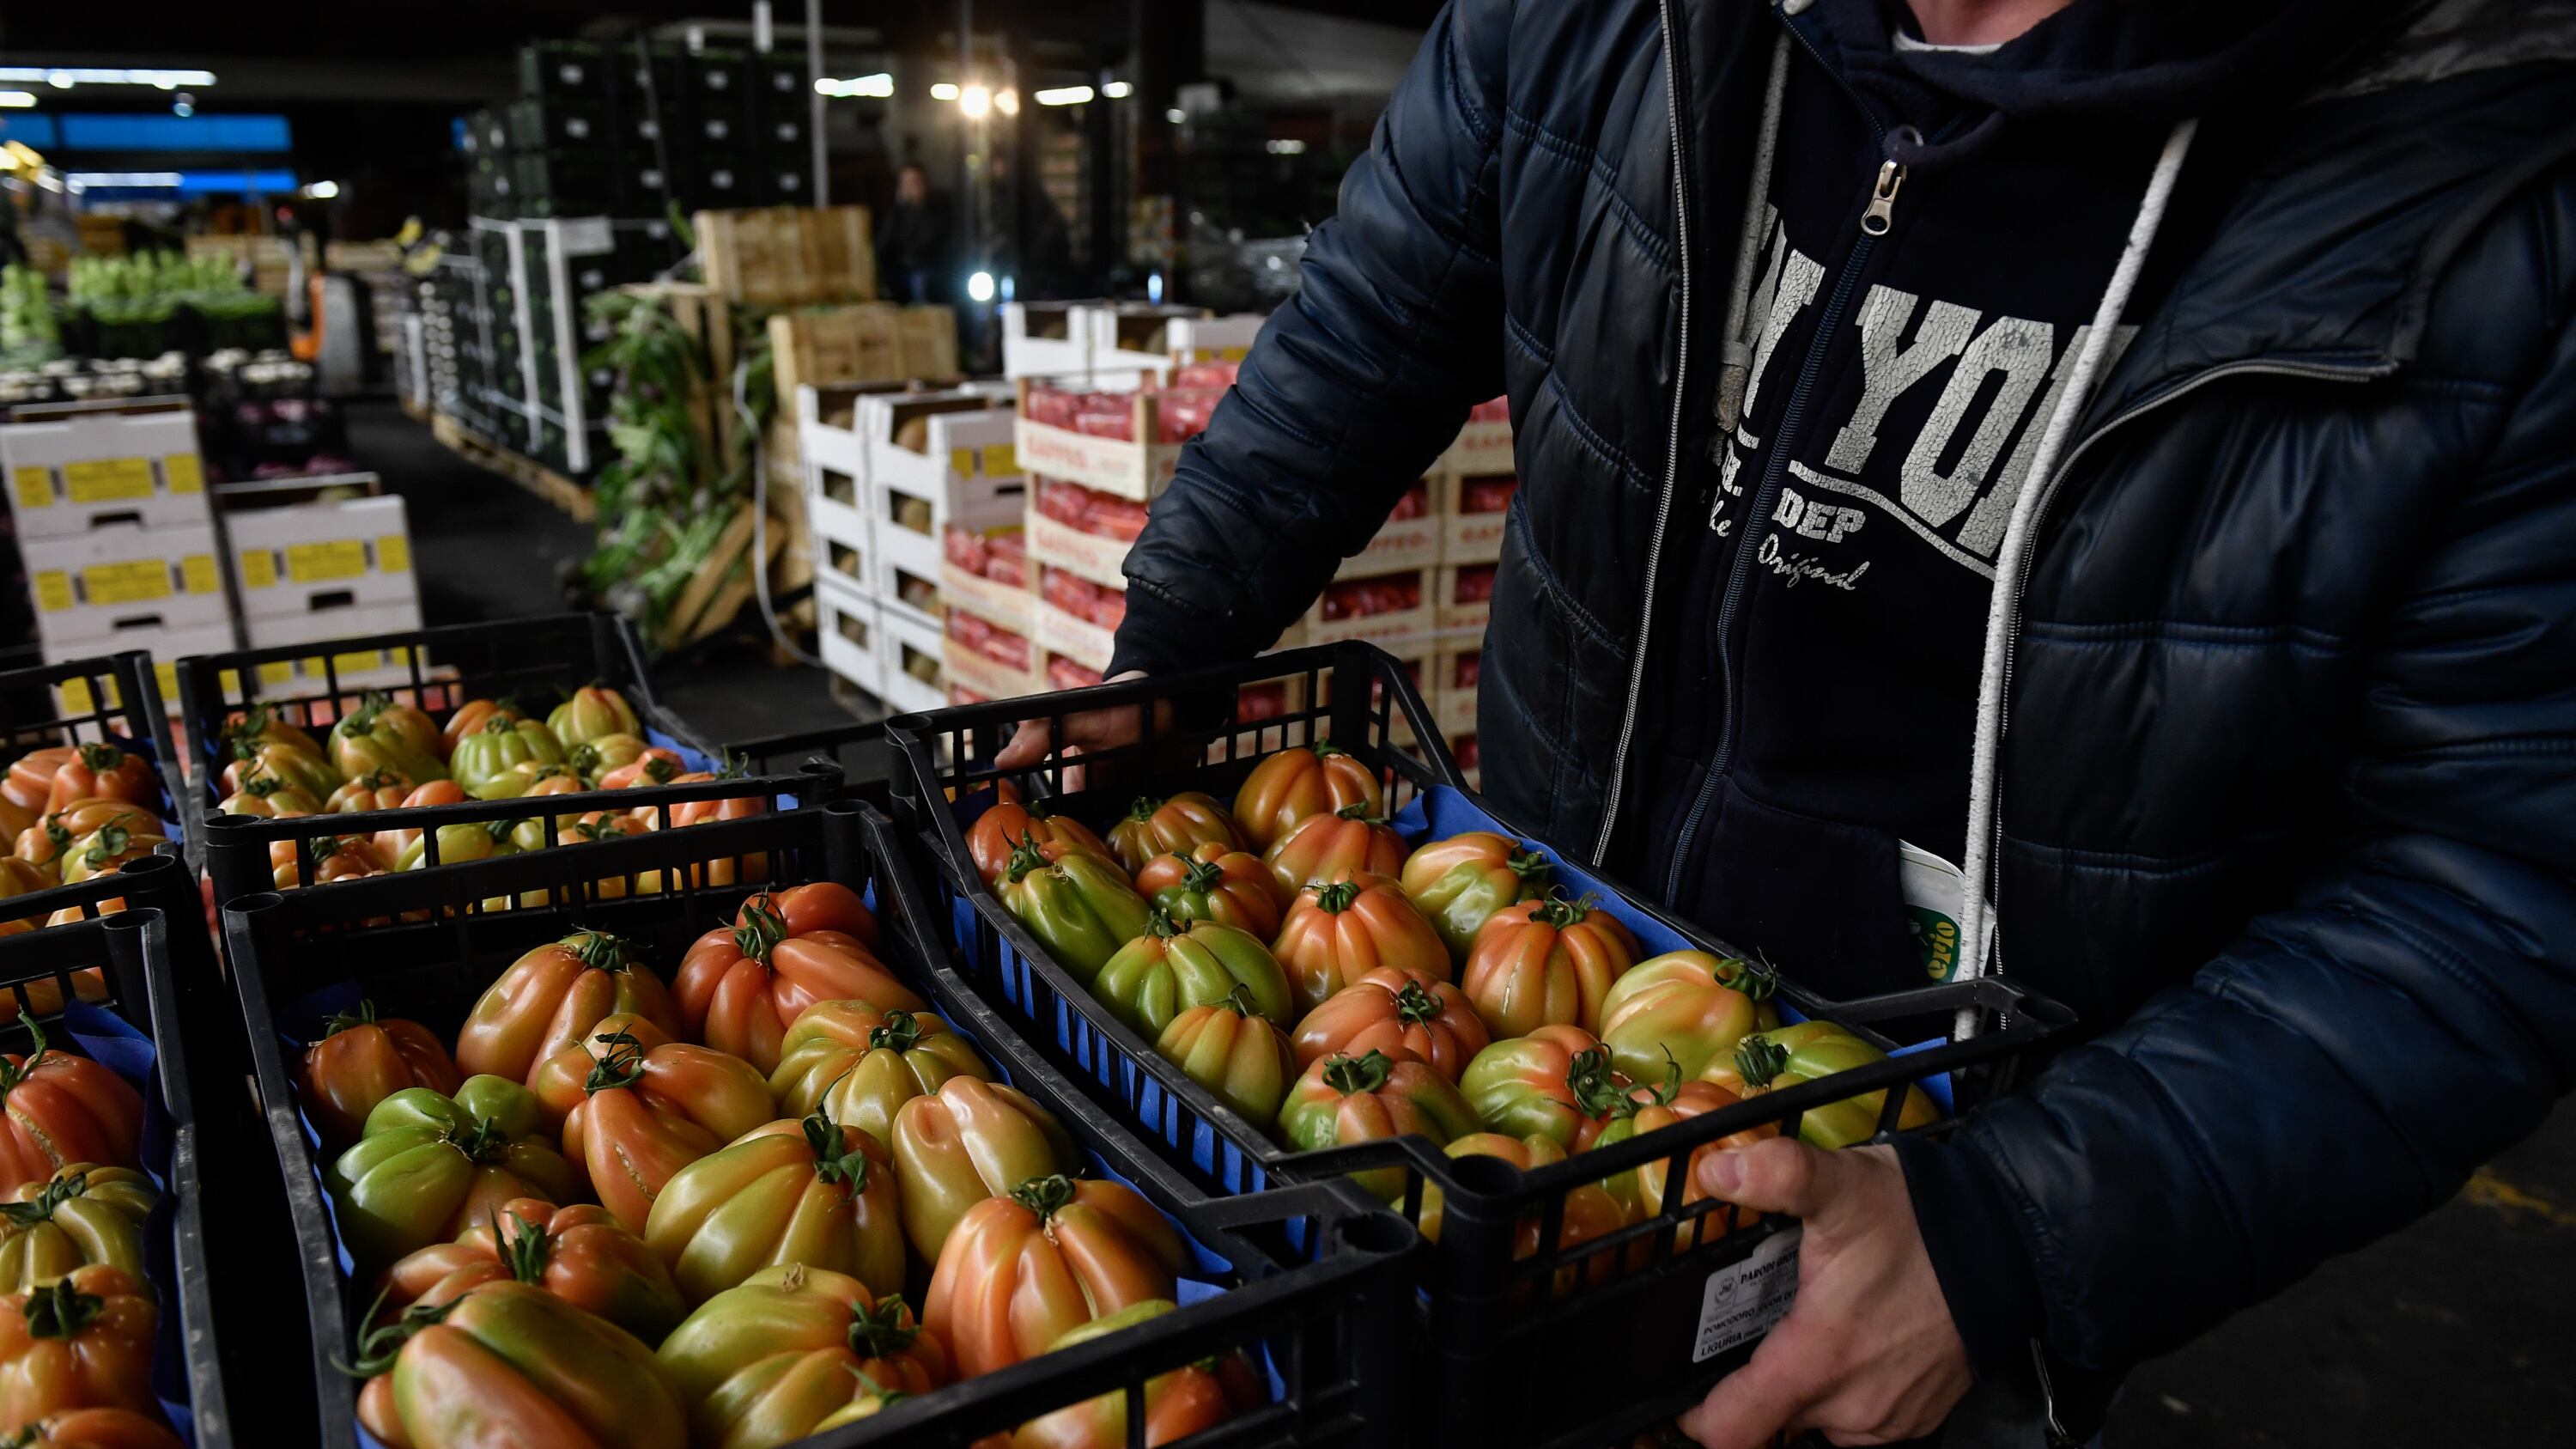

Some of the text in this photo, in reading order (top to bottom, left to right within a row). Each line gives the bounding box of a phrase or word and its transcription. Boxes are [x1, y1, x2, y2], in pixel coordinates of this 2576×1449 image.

[1771, 487, 1867, 544] DEP
[1741, 1260, 1775, 1285] PARODI
[1704, 1307, 1755, 1336] POMODORO
[1700, 1331, 1742, 1357] LIGURIA
